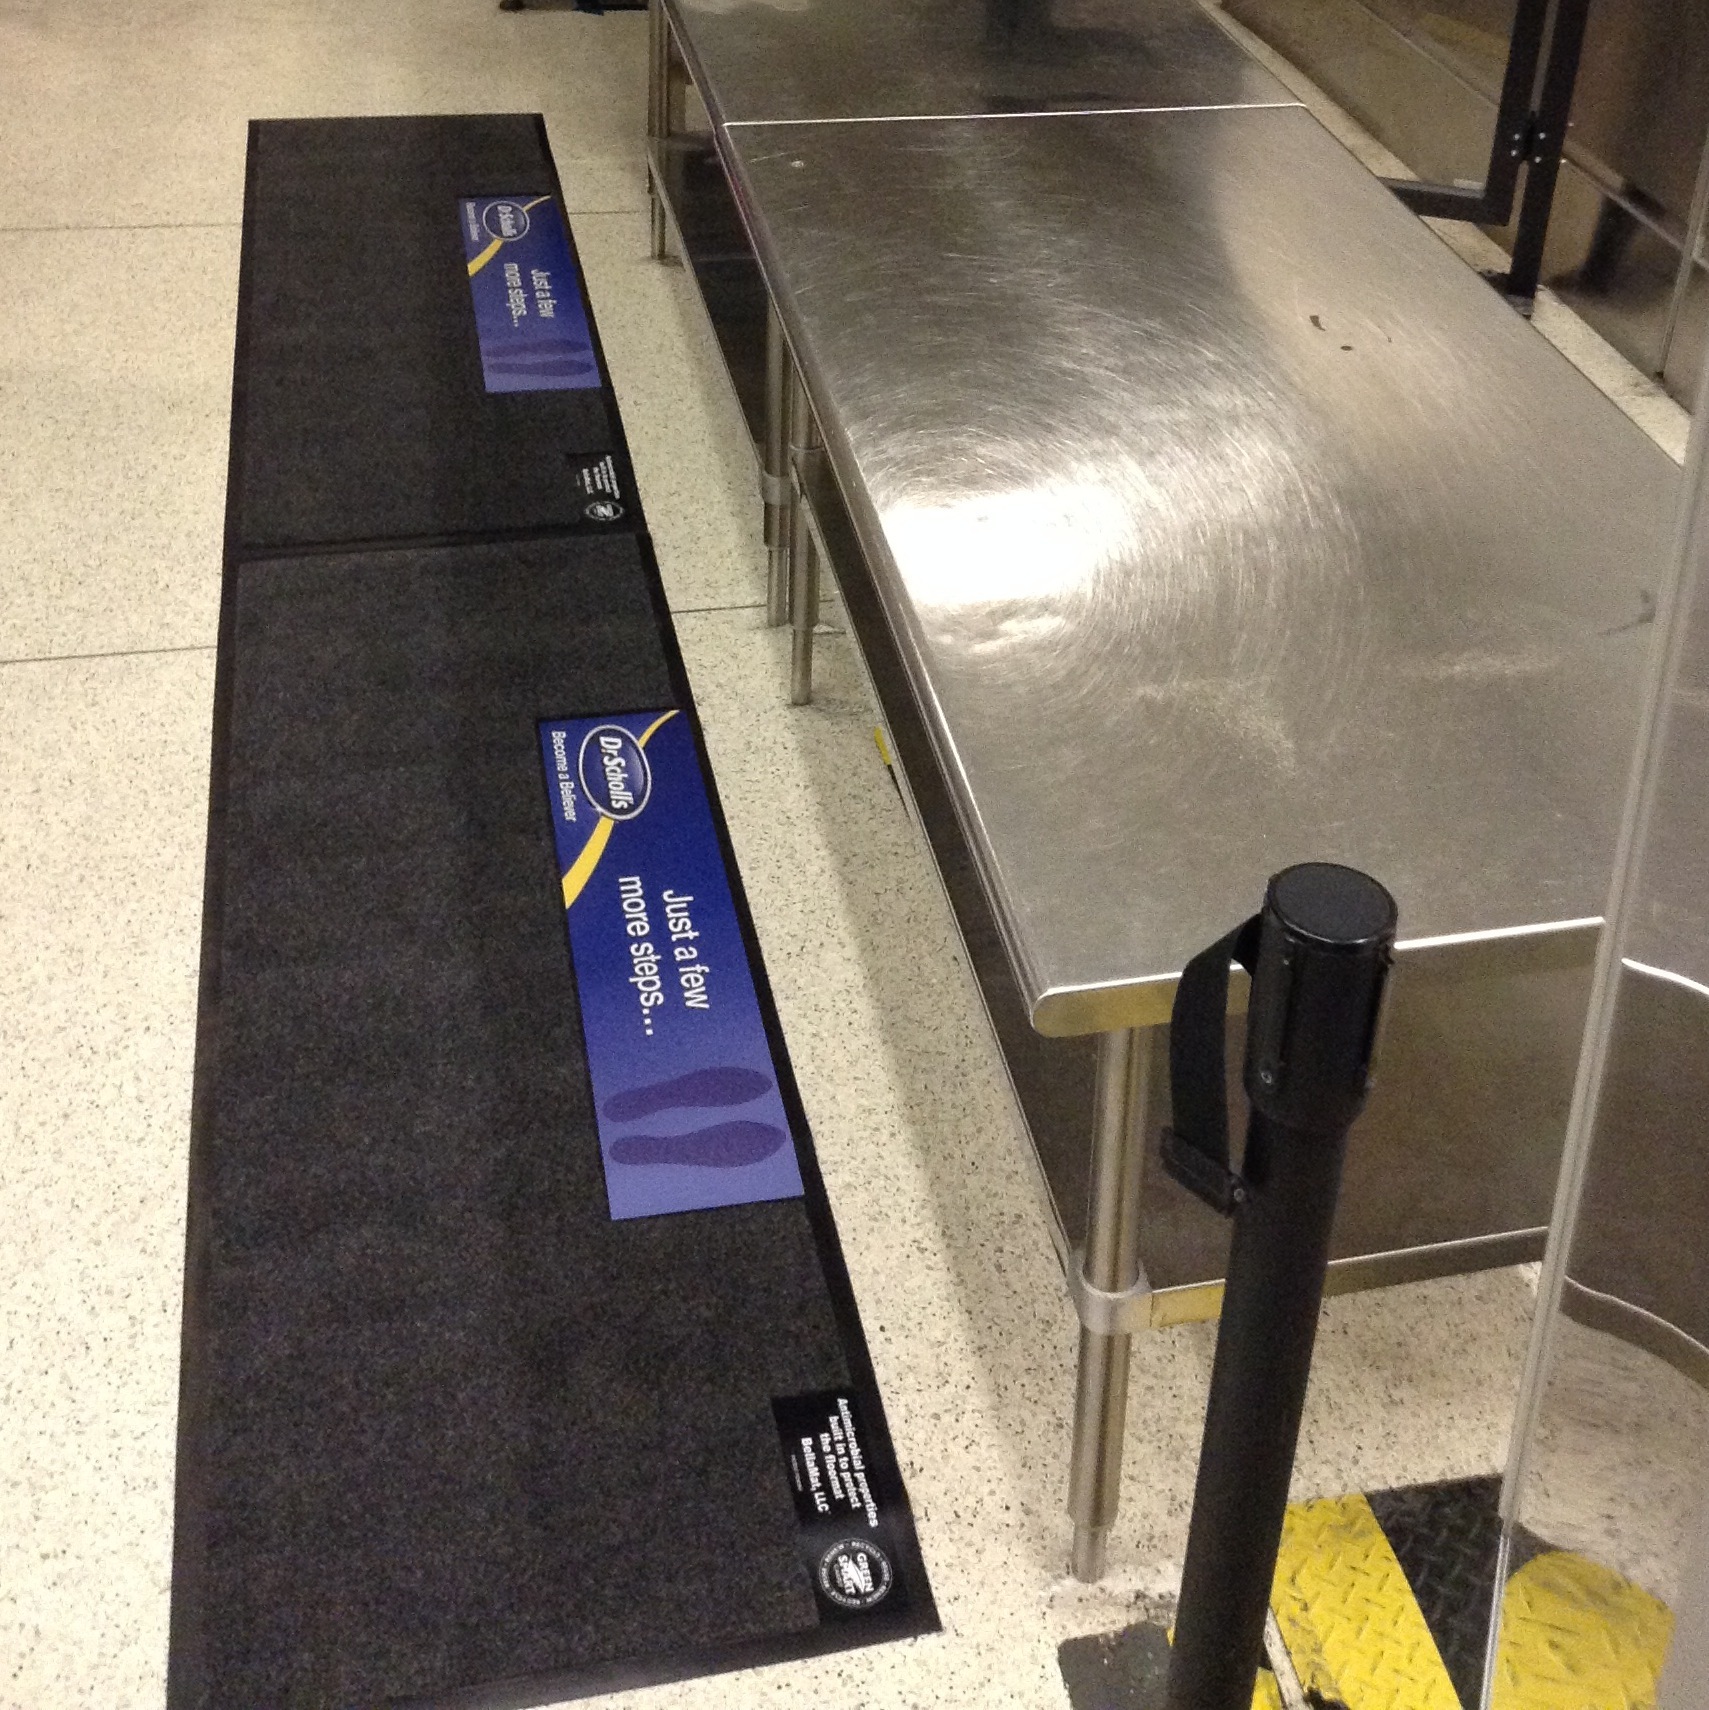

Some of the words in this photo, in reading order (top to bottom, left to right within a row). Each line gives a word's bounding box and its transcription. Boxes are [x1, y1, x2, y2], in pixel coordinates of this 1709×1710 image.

[503, 263, 522, 288] more
[531, 269, 553, 290] Just
[535, 290, 551, 299] a
[537, 299, 557, 318] few
[551, 730, 569, 772] Become
[558, 772, 570, 780] a
[559, 781, 577, 822] Believer
[618, 875, 651, 938] more
[662, 889, 700, 942] Just
[673, 946, 699, 962] a
[628, 941, 665, 1036] steps...
[678, 963, 711, 1009] few
[820, 1432, 832, 1453] the
[828, 1415, 844, 1441] built
[835, 1442, 847, 1455] in
[837, 1398, 866, 1471] Antimicrobial
[853, 1471, 879, 1527] properties
[838, 1456, 850, 1470] to
[824, 1454, 846, 1499] floormat
[840, 1471, 862, 1509] protect
[814, 1492, 830, 1513] LLC
[838, 1554, 856, 1596] SMART
[856, 1552, 875, 1593] GREEN
